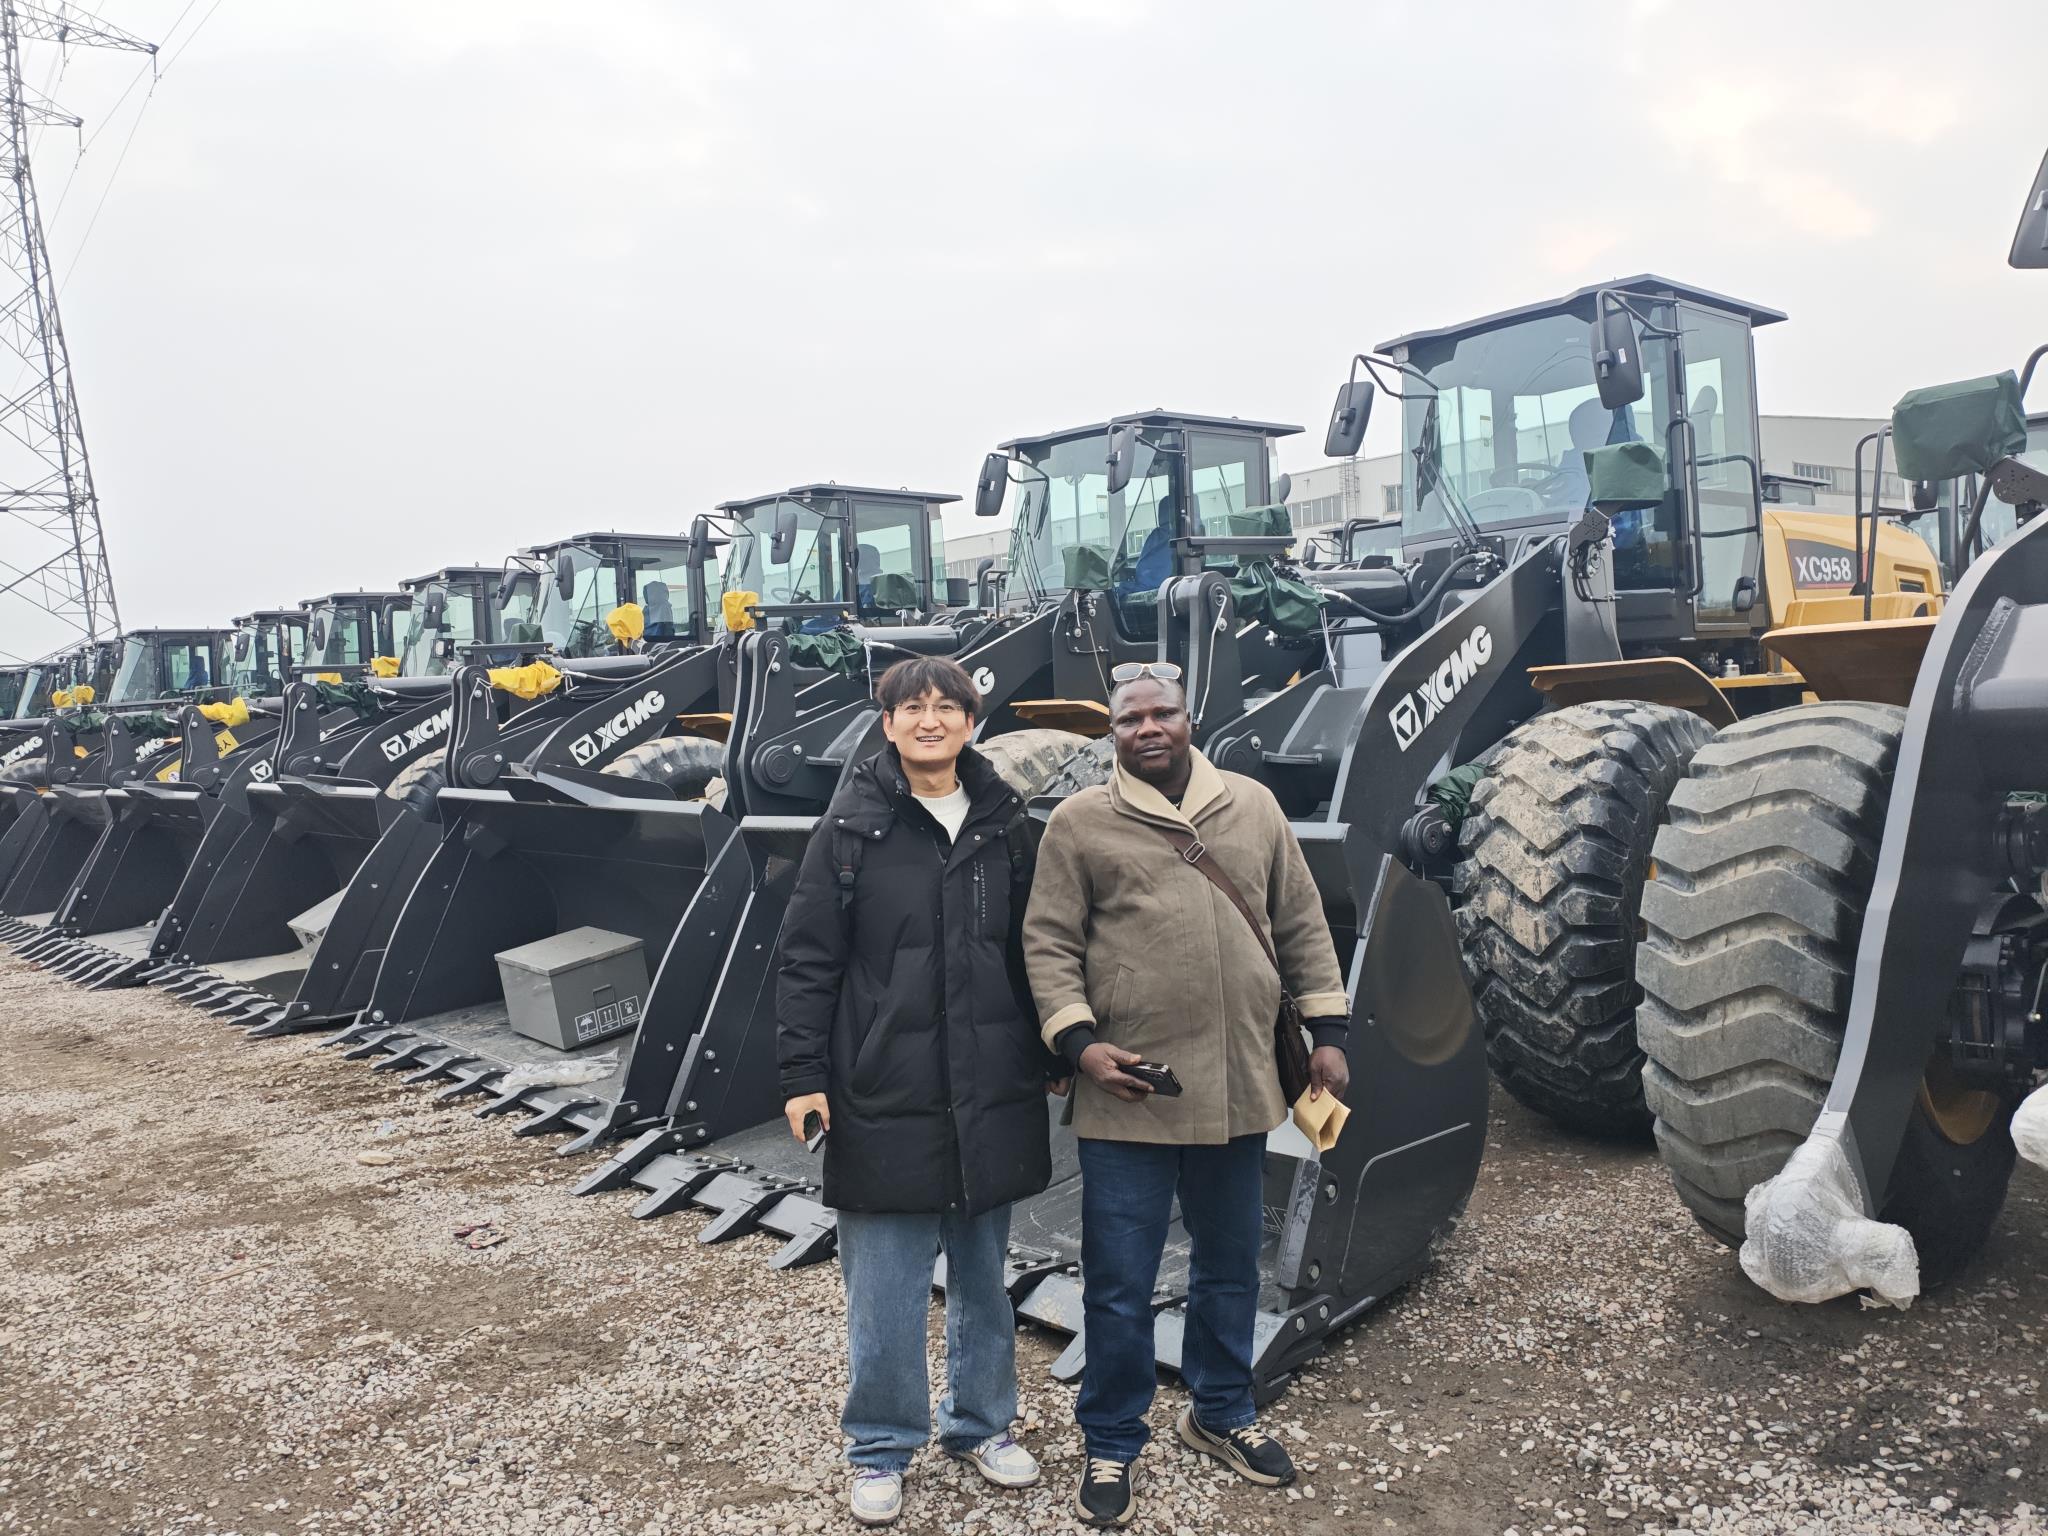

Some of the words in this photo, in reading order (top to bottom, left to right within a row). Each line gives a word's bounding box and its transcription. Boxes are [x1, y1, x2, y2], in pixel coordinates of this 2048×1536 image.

[1795, 556, 1852, 582] XC958
[1417, 625, 1493, 729] XCMG
[403, 704, 453, 751] XCM
[594, 690, 665, 752] XCMG
